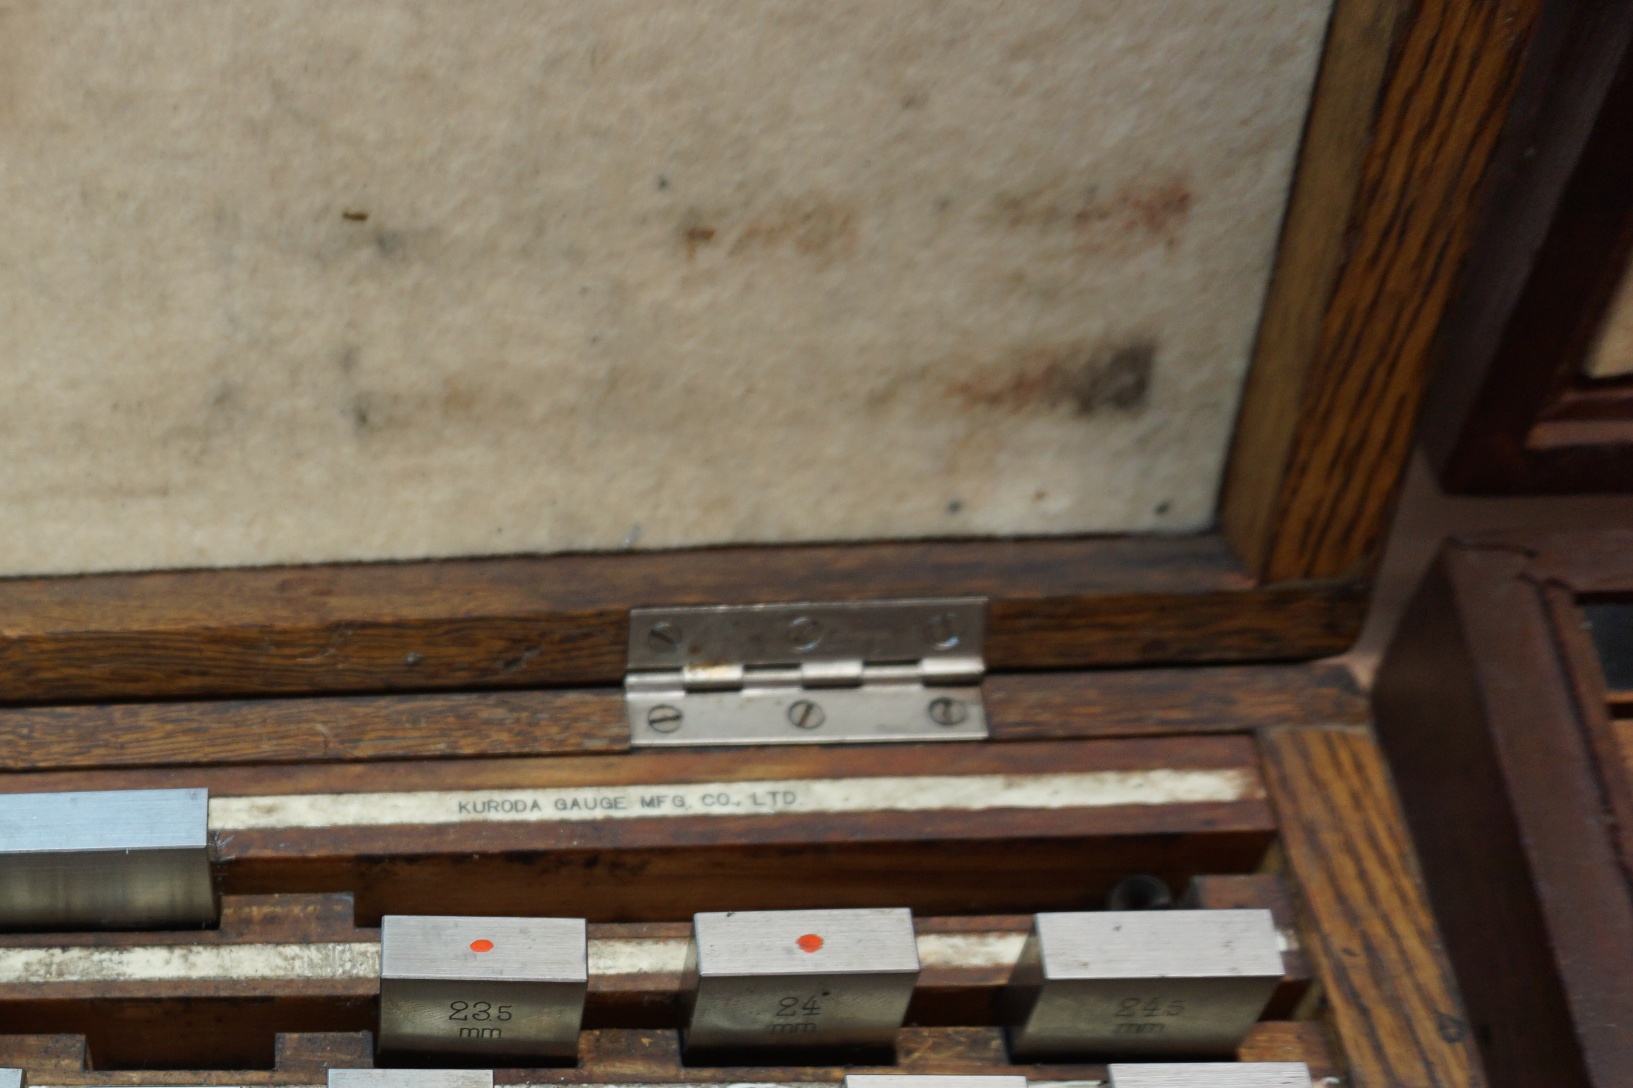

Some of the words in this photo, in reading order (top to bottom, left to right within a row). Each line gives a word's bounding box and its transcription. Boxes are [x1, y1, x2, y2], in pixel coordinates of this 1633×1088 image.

[458, 798, 541, 814] KURODA
[553, 796, 627, 811] GAUGE
[776, 994, 822, 1017] 24
[459, 1027, 502, 1039] mm
[771, 1022, 816, 1034] mm
